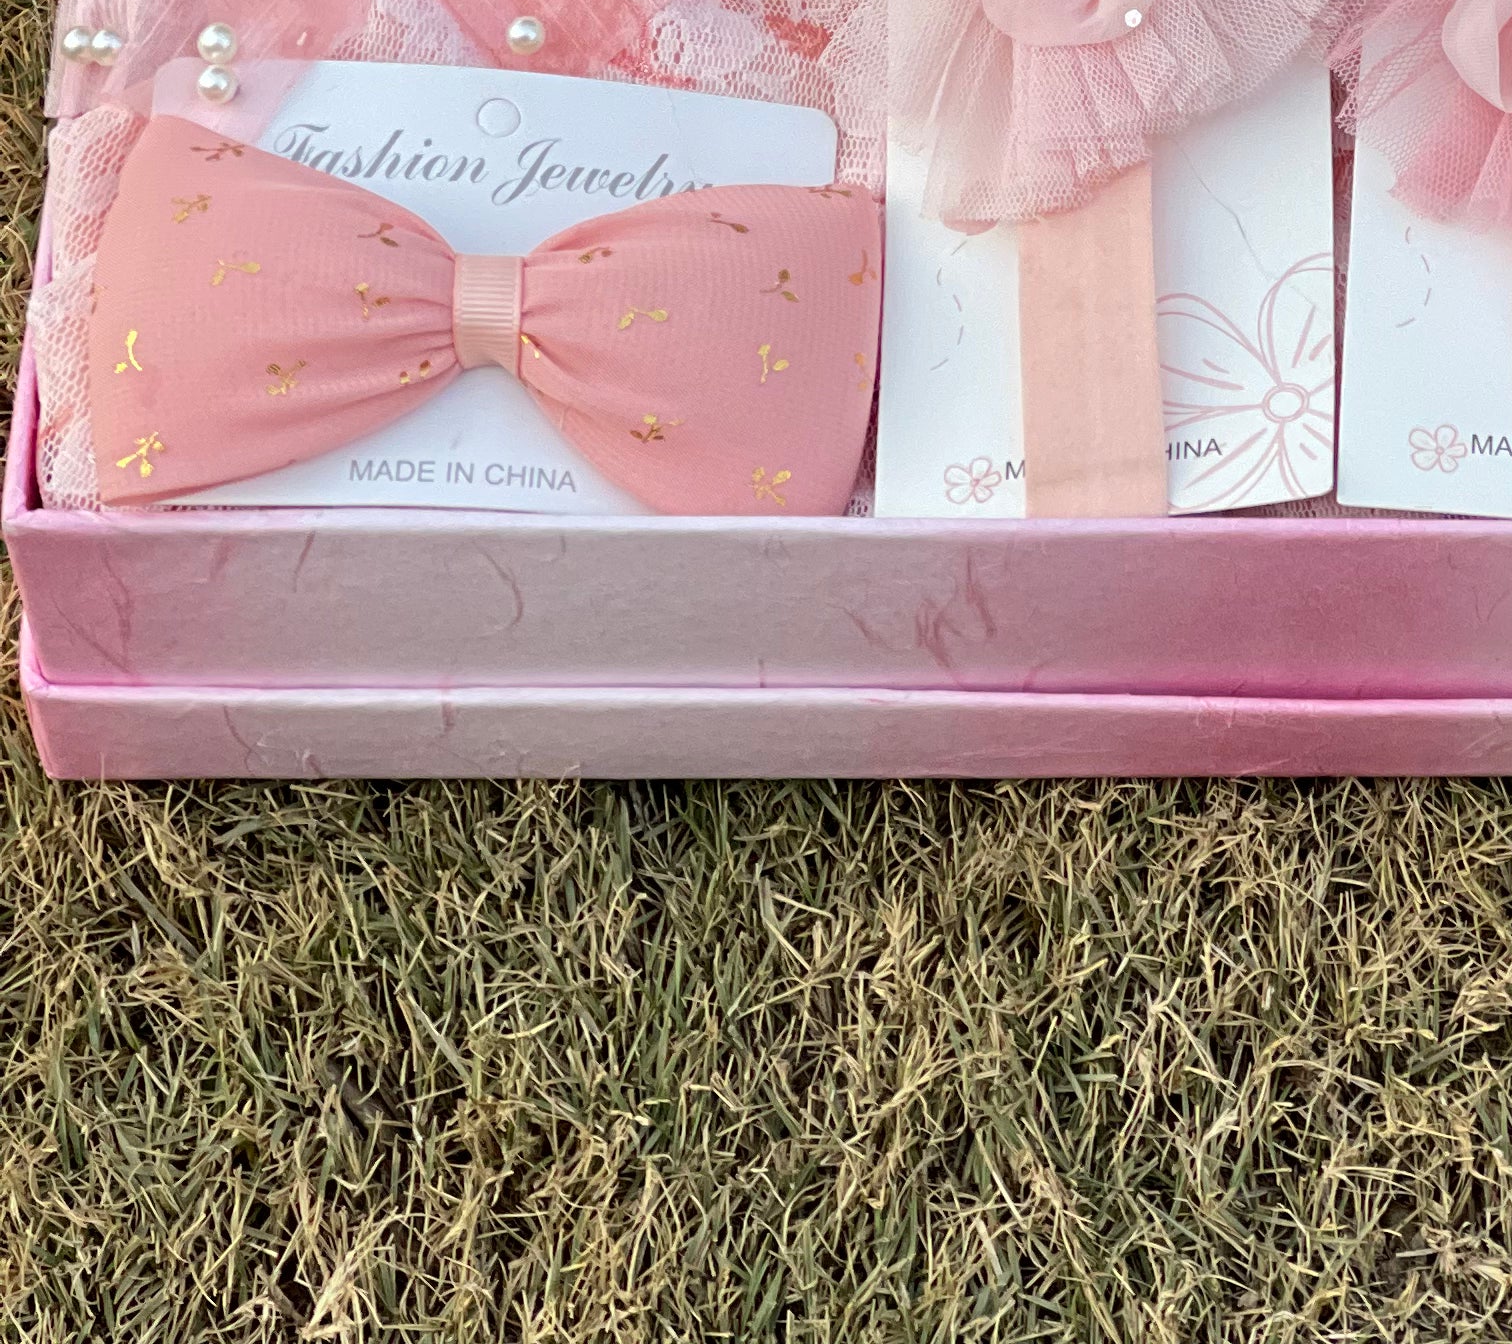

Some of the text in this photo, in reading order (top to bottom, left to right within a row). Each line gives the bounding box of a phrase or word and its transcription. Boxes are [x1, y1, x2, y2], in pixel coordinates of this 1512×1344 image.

[273, 124, 489, 183] Fashion
[349, 459, 577, 492] MADE IN CHINA
